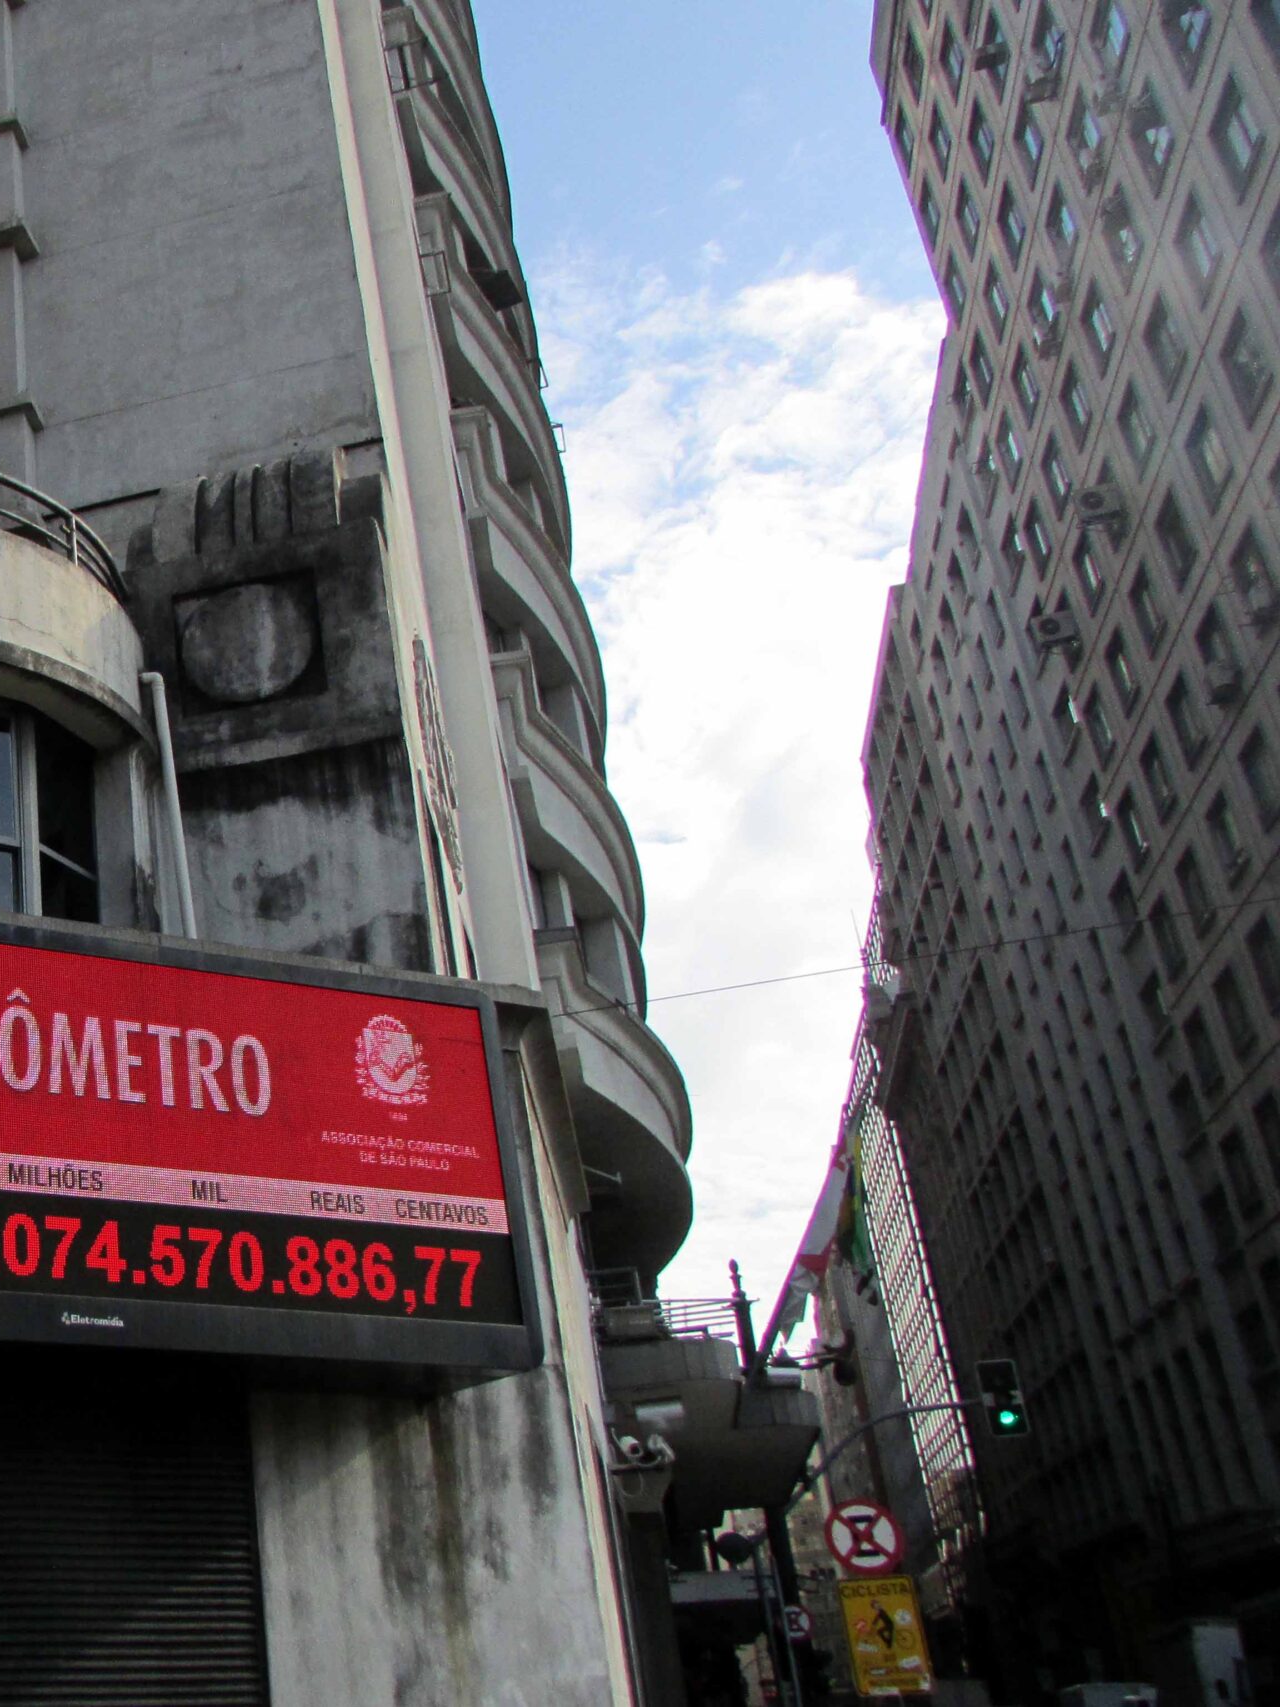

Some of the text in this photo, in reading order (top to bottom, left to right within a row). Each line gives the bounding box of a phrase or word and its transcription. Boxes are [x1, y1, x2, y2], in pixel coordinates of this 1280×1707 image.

[321, 1130, 480, 1159] ASSOCIAÇÃO COMERCIAL
[359, 1151, 450, 1171] DE SÃO PAULO
[7, 1162, 104, 1192] MILHÕES
[191, 1179, 228, 1203] MIL
[311, 1190, 366, 1215] REAIS
[395, 1198, 490, 1226] CENTAVOS
[840, 1582, 910, 1599] CICLISTA
